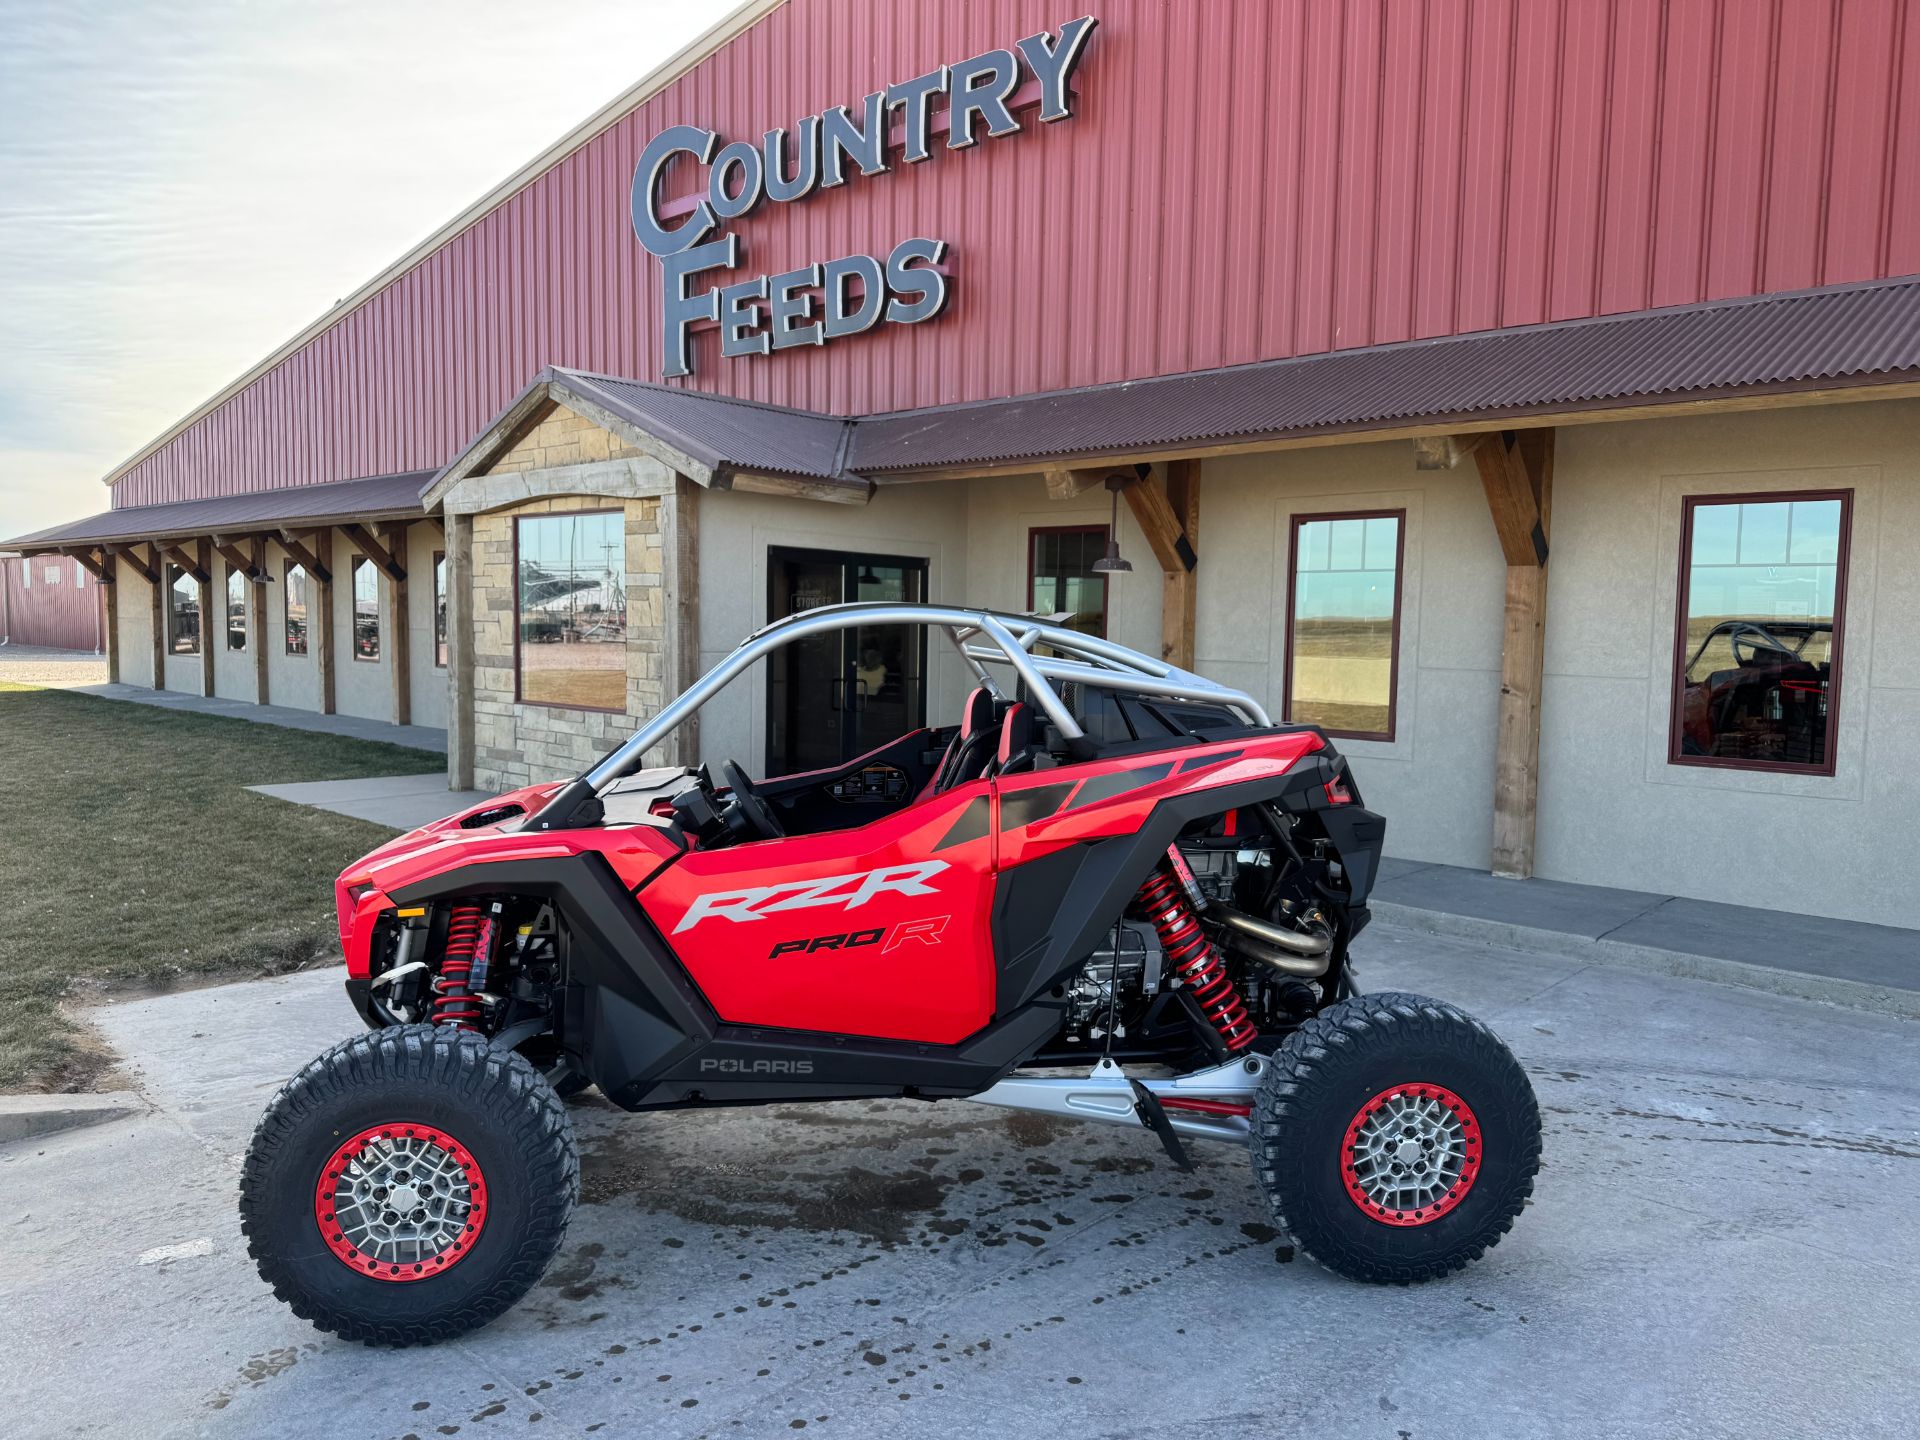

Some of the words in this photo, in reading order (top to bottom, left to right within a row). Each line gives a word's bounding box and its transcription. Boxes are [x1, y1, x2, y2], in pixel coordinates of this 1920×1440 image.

[631, 15, 1098, 257] COUNTRY
[660, 232, 949, 378] FEEDS
[671, 860, 952, 935] RZR
[768, 928, 886, 960] PRO
[881, 915, 951, 955] R
[701, 1059, 814, 1073] POLARIS
